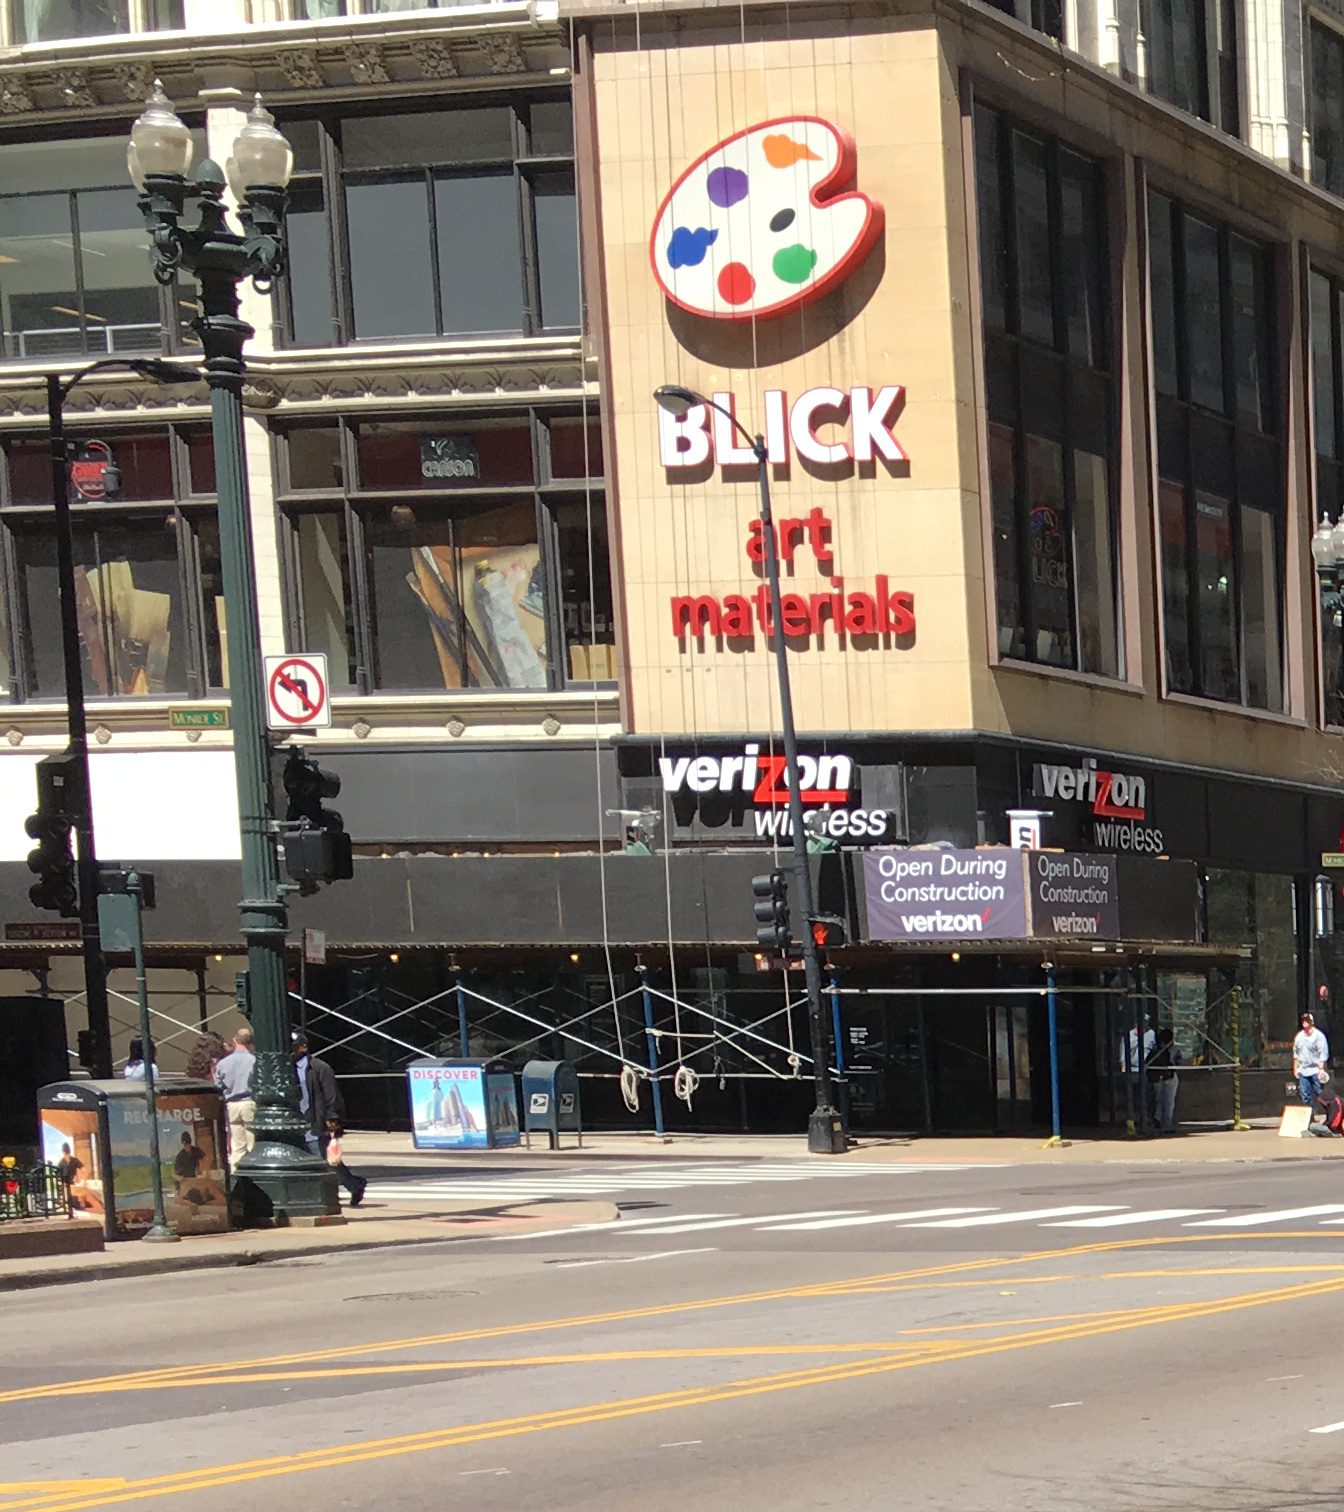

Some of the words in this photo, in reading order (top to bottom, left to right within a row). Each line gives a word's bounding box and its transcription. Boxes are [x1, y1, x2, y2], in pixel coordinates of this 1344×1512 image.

[656, 385, 909, 467] BLICK
[746, 507, 833, 563] art
[670, 574, 916, 639] materials
[658, 743, 853, 802] verizon
[1040, 758, 1146, 820] verizon
[1095, 817, 1164, 853] wireless
[879, 855, 933, 881] Open
[940, 855, 1007, 880] During
[1038, 855, 1070, 883] Open
[1073, 858, 1109, 884] During
[880, 881, 1005, 903] Construction
[1039, 881, 1108, 904] Construction
[901, 910, 983, 932] verizon
[1052, 911, 1097, 934] verizon
[413, 1070, 478, 1080] DISCOVER
